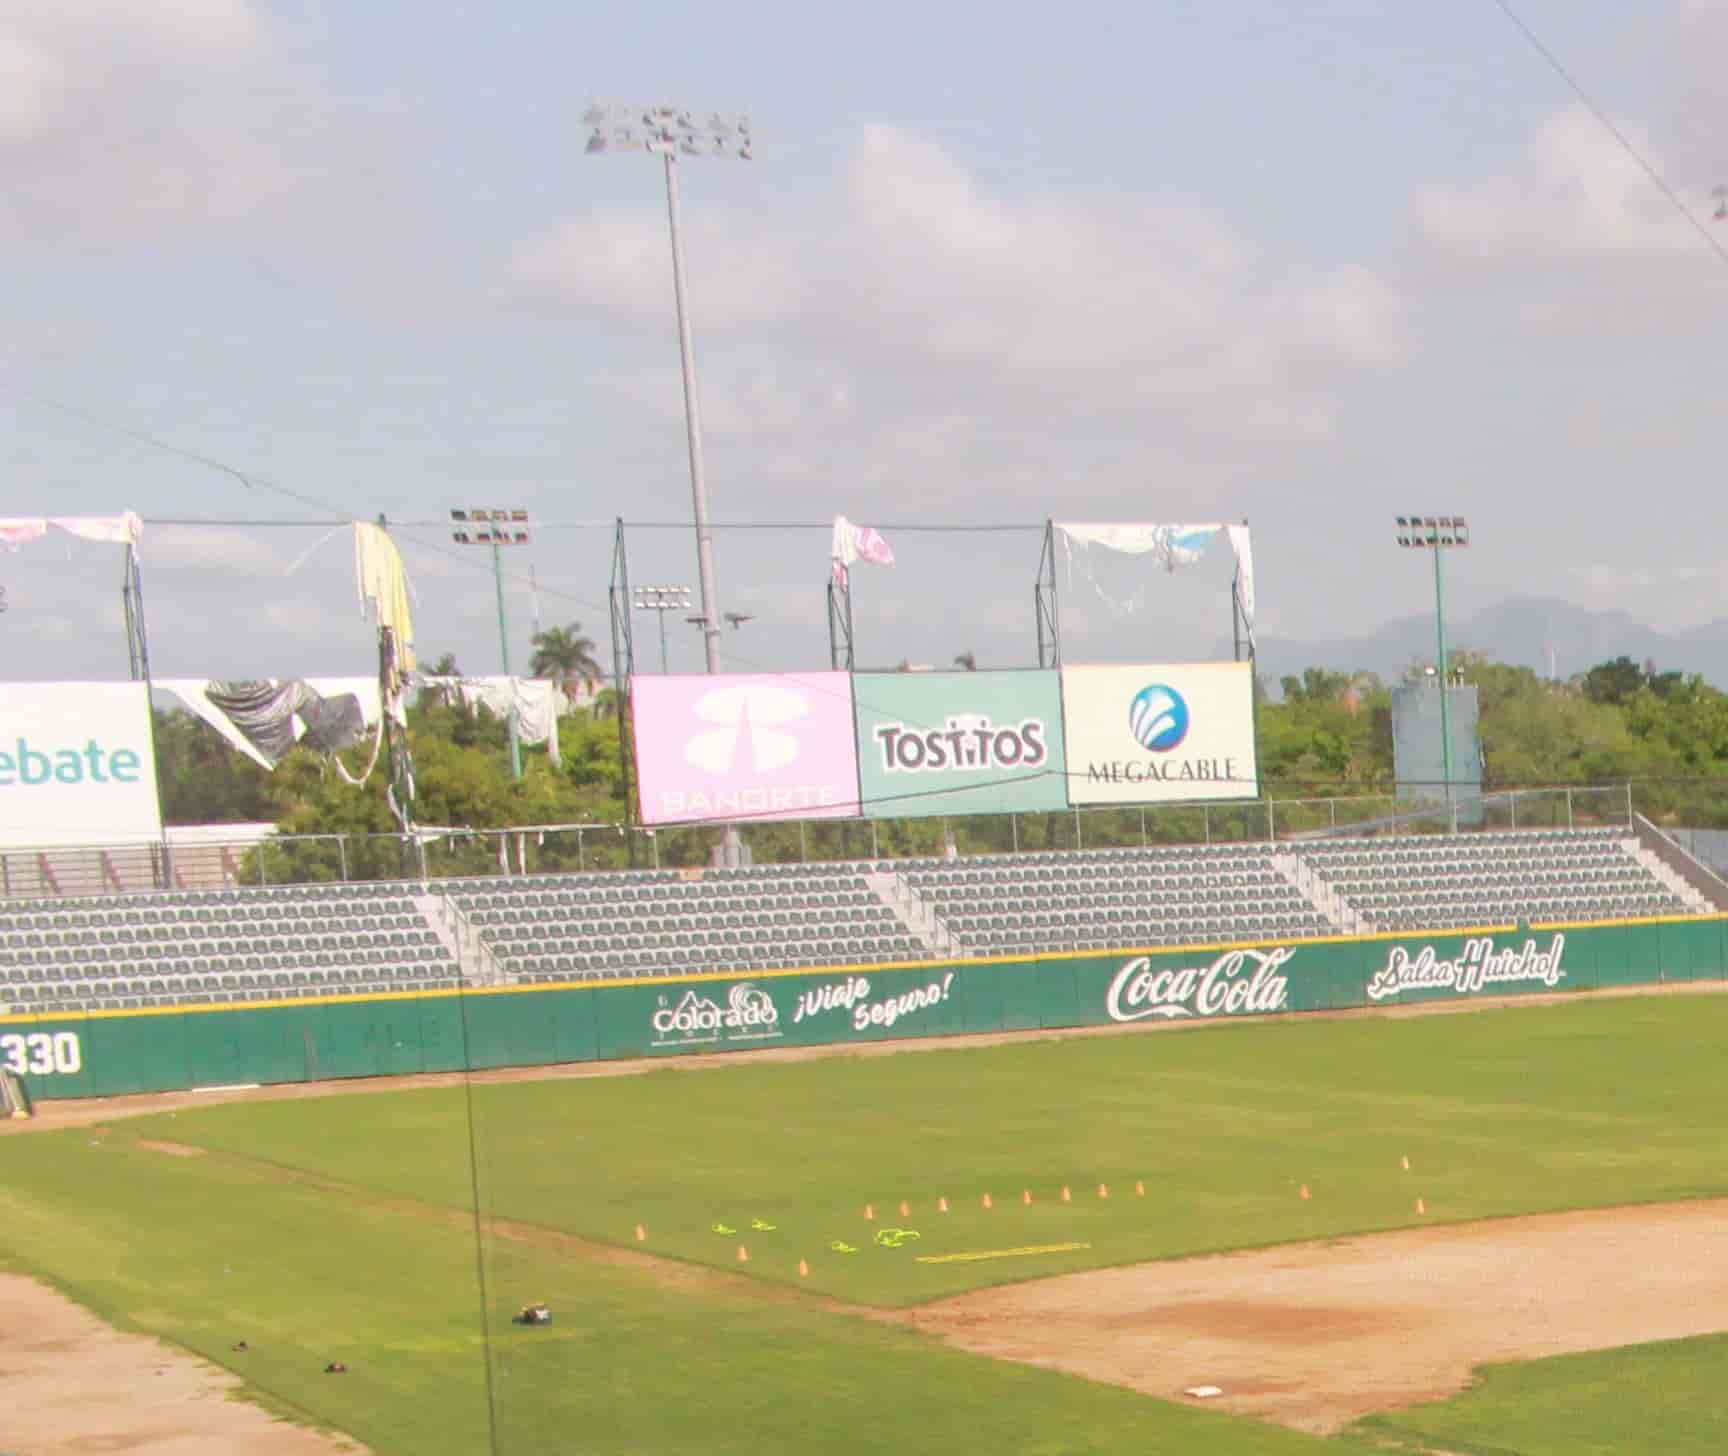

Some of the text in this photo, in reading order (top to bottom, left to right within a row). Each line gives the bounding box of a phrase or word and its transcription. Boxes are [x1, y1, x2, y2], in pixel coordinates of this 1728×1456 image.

[1087, 756, 1239, 785] MEGACABLE
[1107, 946, 1296, 1022] Coca-Cola
[1367, 933, 1564, 999] Salsa Huichol
[0, 1031, 81, 1075] 330
